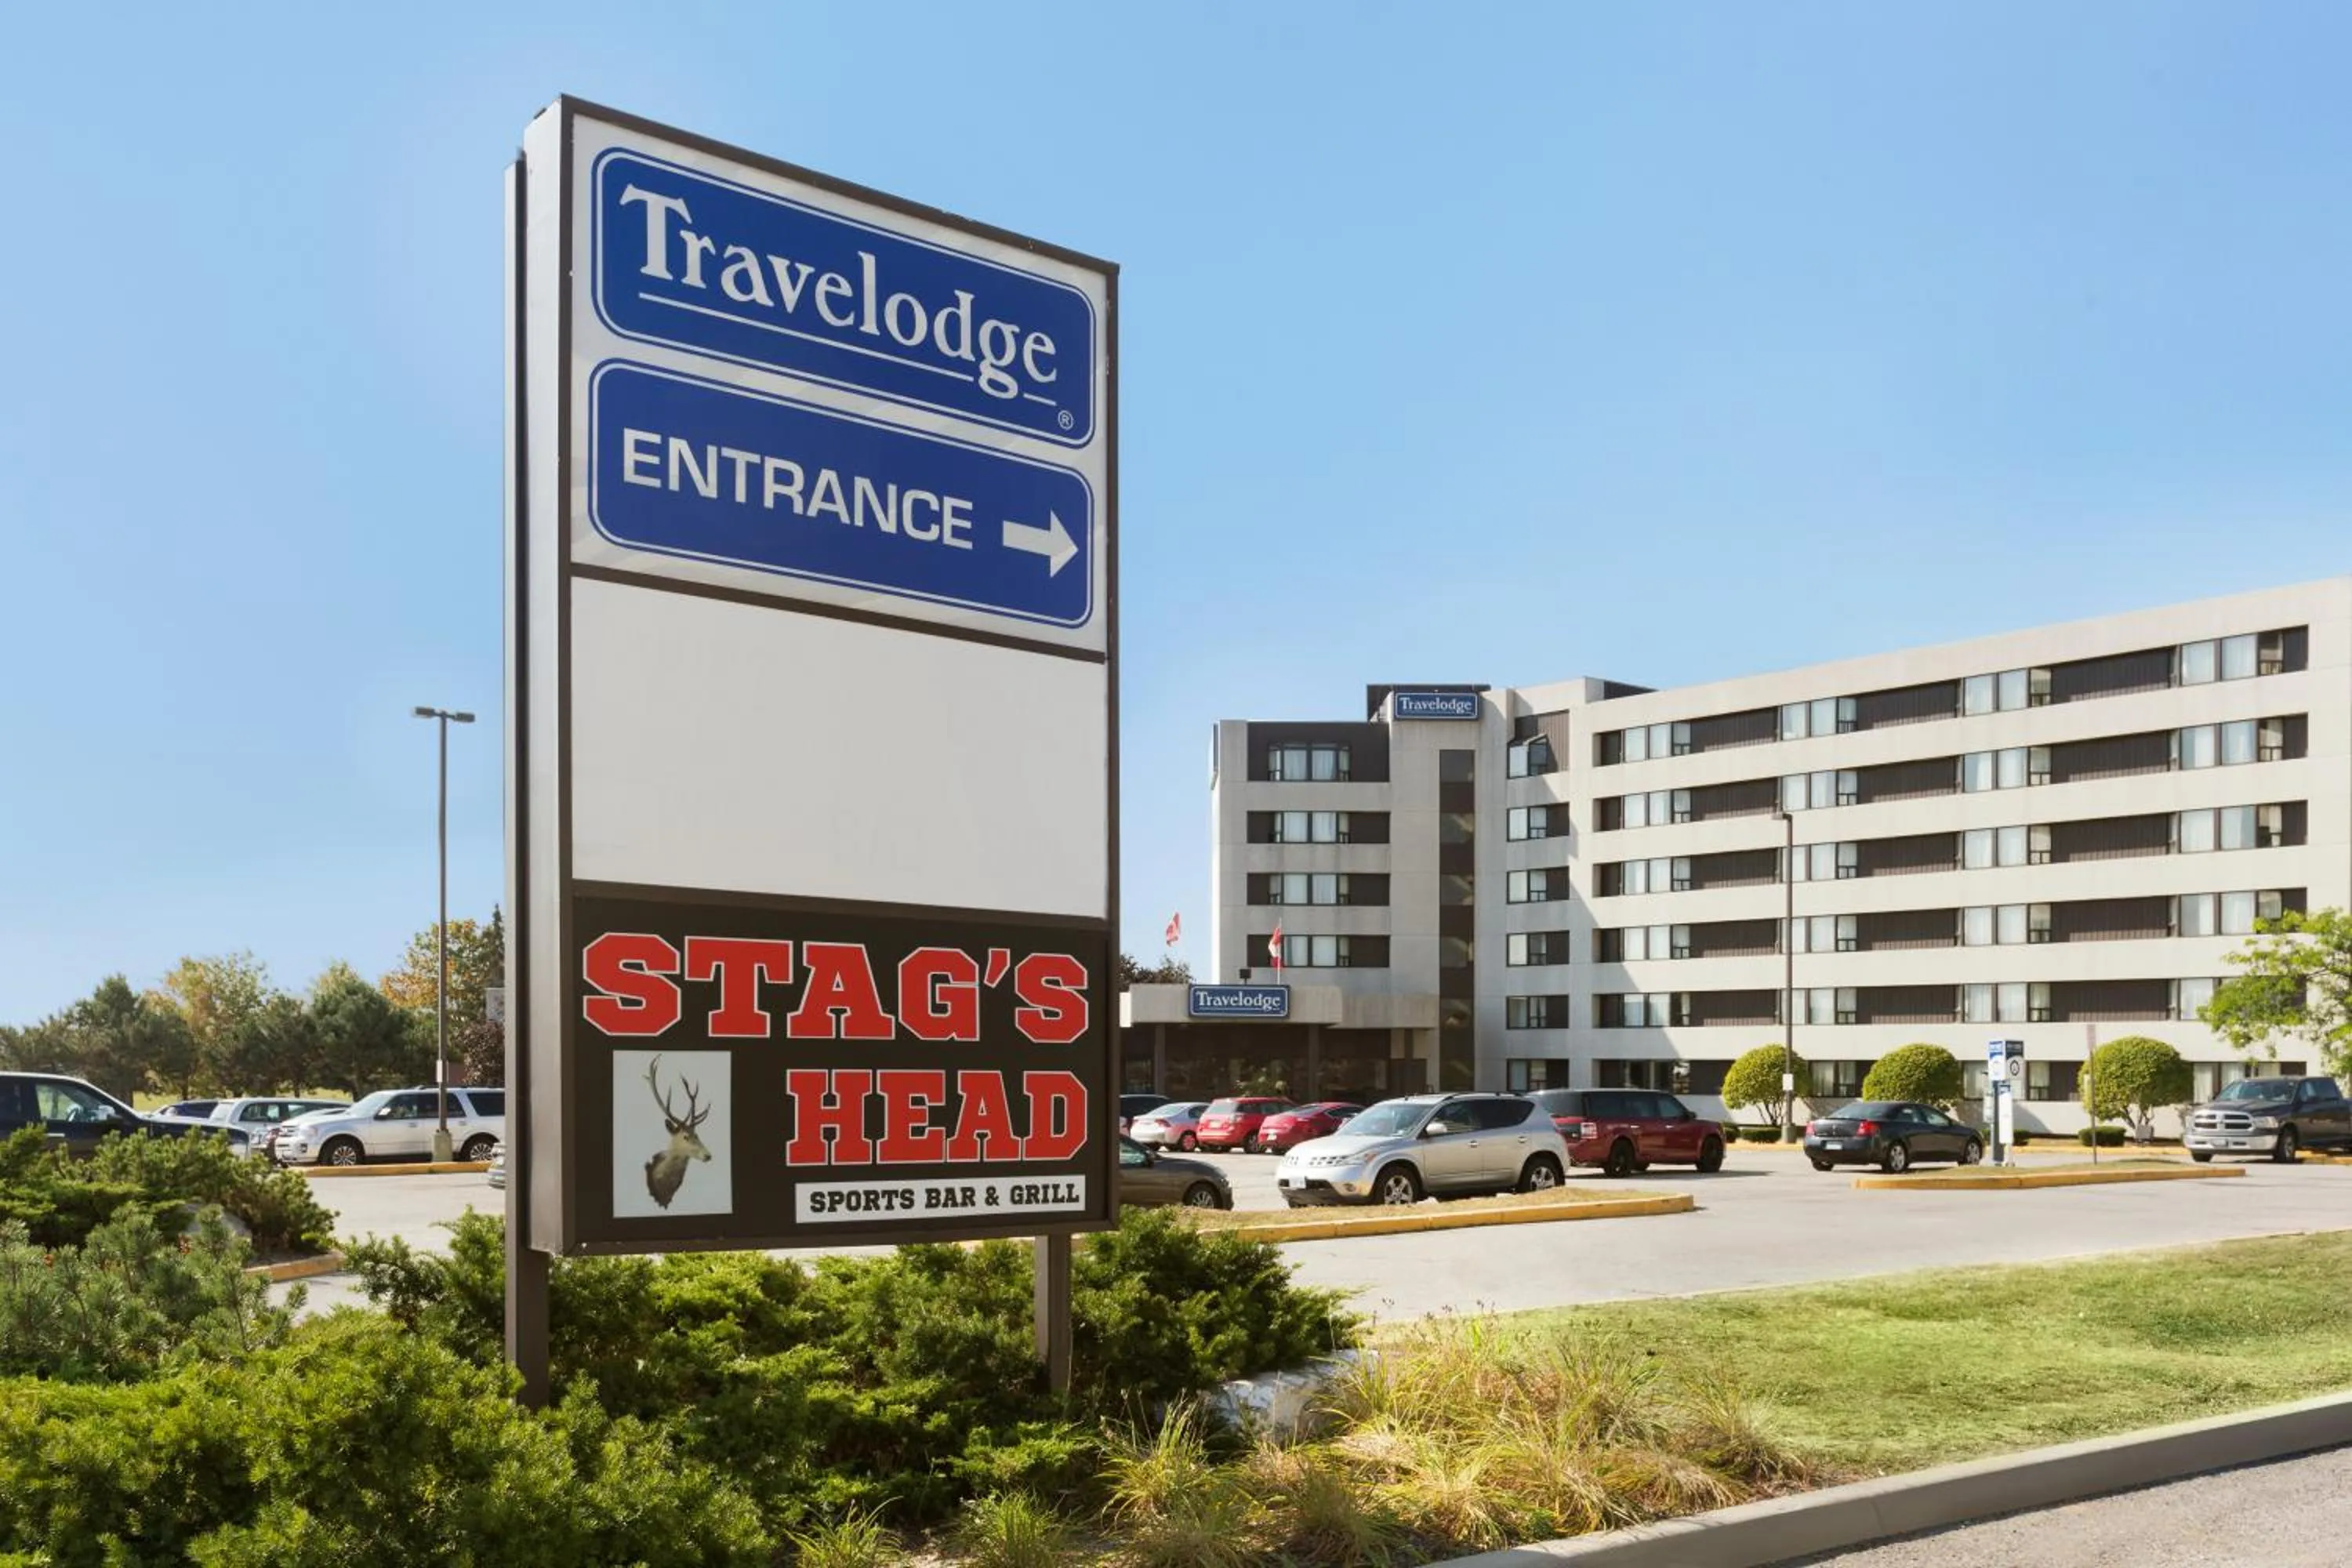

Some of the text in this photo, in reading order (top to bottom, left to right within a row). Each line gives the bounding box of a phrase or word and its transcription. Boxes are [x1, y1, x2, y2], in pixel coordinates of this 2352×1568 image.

[620, 184, 1057, 399] Travelodge
[622, 427, 973, 550] ENTRANCE
[1399, 696, 1472, 714] Travelodge
[583, 932, 1088, 1044] STAG'S
[1196, 990, 1280, 1011] Travelodge
[786, 1069, 1087, 1166] HEAD
[809, 1183, 1080, 1213] SPORTS BAR & GRILL
